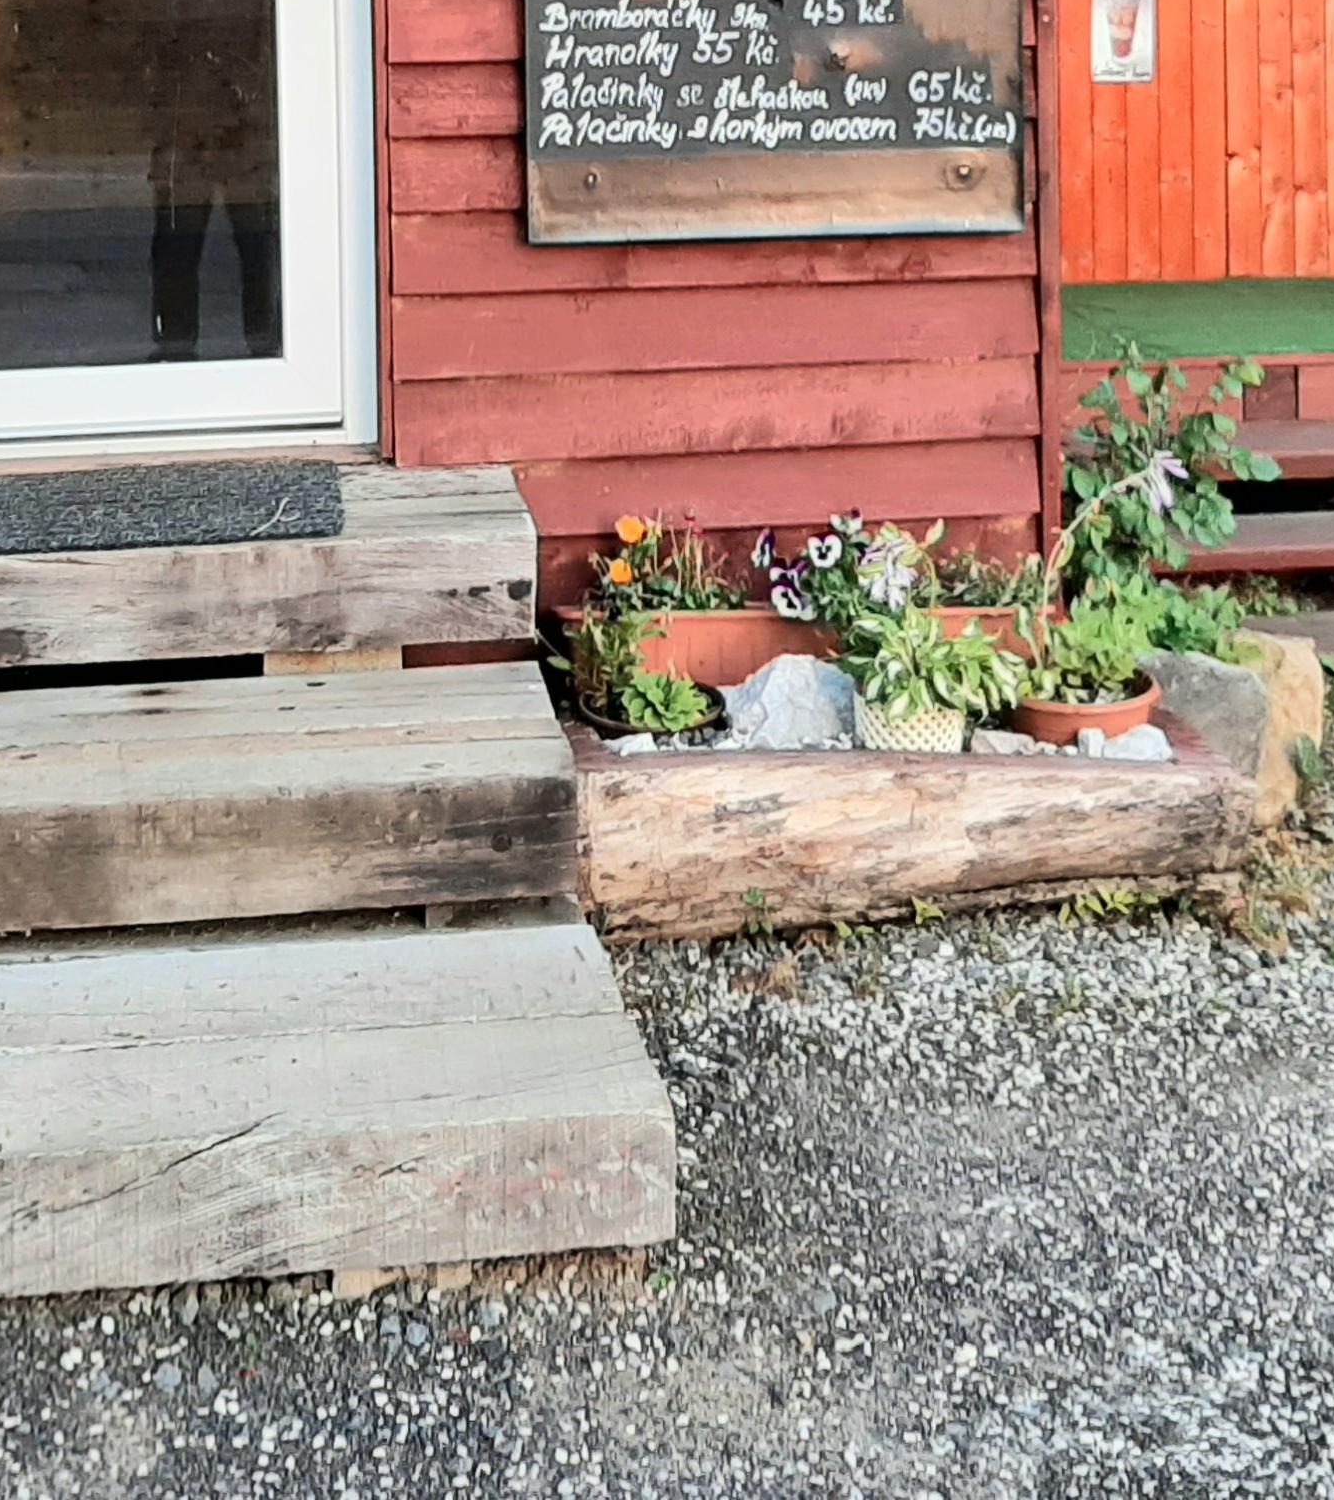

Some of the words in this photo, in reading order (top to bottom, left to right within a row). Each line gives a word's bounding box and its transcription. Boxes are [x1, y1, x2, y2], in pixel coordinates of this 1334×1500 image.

[545, 29, 679, 77] Hranolky
[692, 31, 740, 65] 55
[540, 72, 664, 111] Palačinky
[676, 84, 704, 107] se
[908, 70, 952, 103] 65
[710, 109, 803, 149] horkým
[810, 117, 897, 142] ovocem
[913, 107, 945, 140] 75
